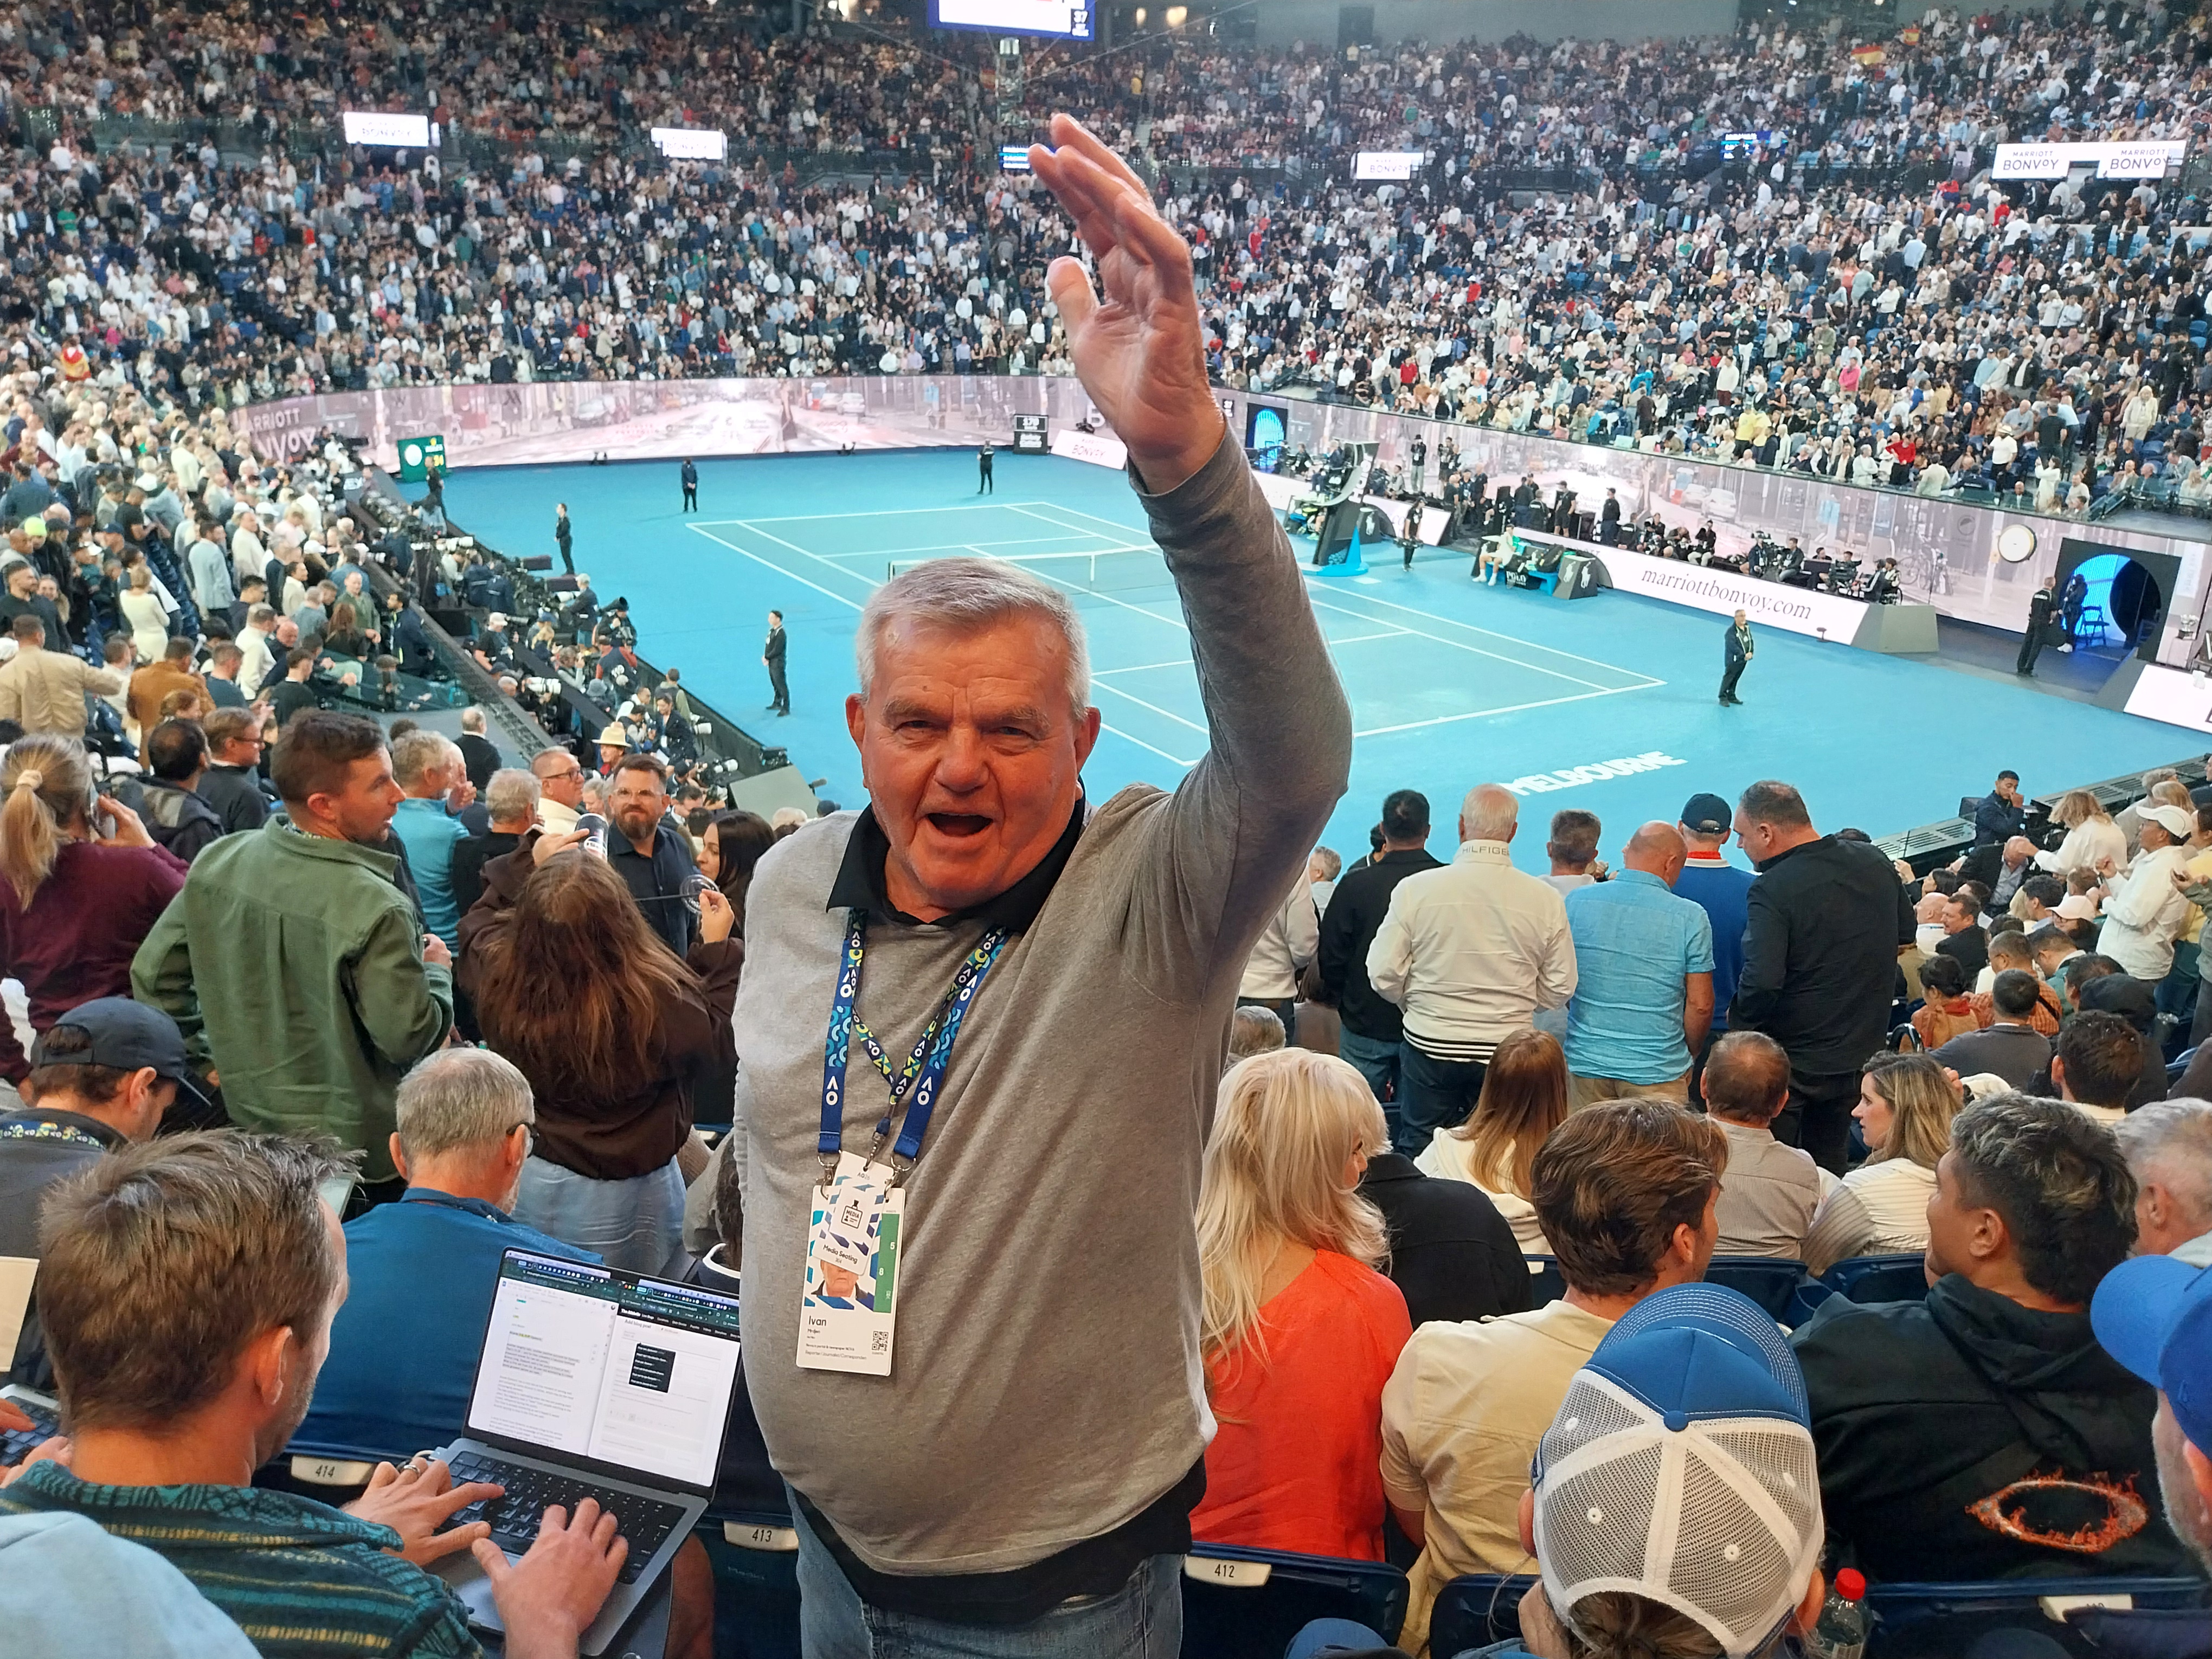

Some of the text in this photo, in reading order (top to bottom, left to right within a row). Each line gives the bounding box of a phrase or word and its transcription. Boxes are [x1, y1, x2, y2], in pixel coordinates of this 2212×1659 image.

[2003, 158, 2059, 170] BONVOY
[1641, 568, 1812, 620] marriottbonvoy.com
[1498, 751, 1688, 796] MELBOURNE
[846, 1209, 860, 1219] MEDIA
[890, 1242, 896, 1250] 5
[823, 1244, 858, 1264] Media Seating
[879, 1268, 884, 1276] 8
[809, 1315, 827, 1327] Ivan
[316, 1464, 336, 1477] 414
[752, 1528, 772, 1542] 413
[1214, 1564, 1234, 1578] 412
